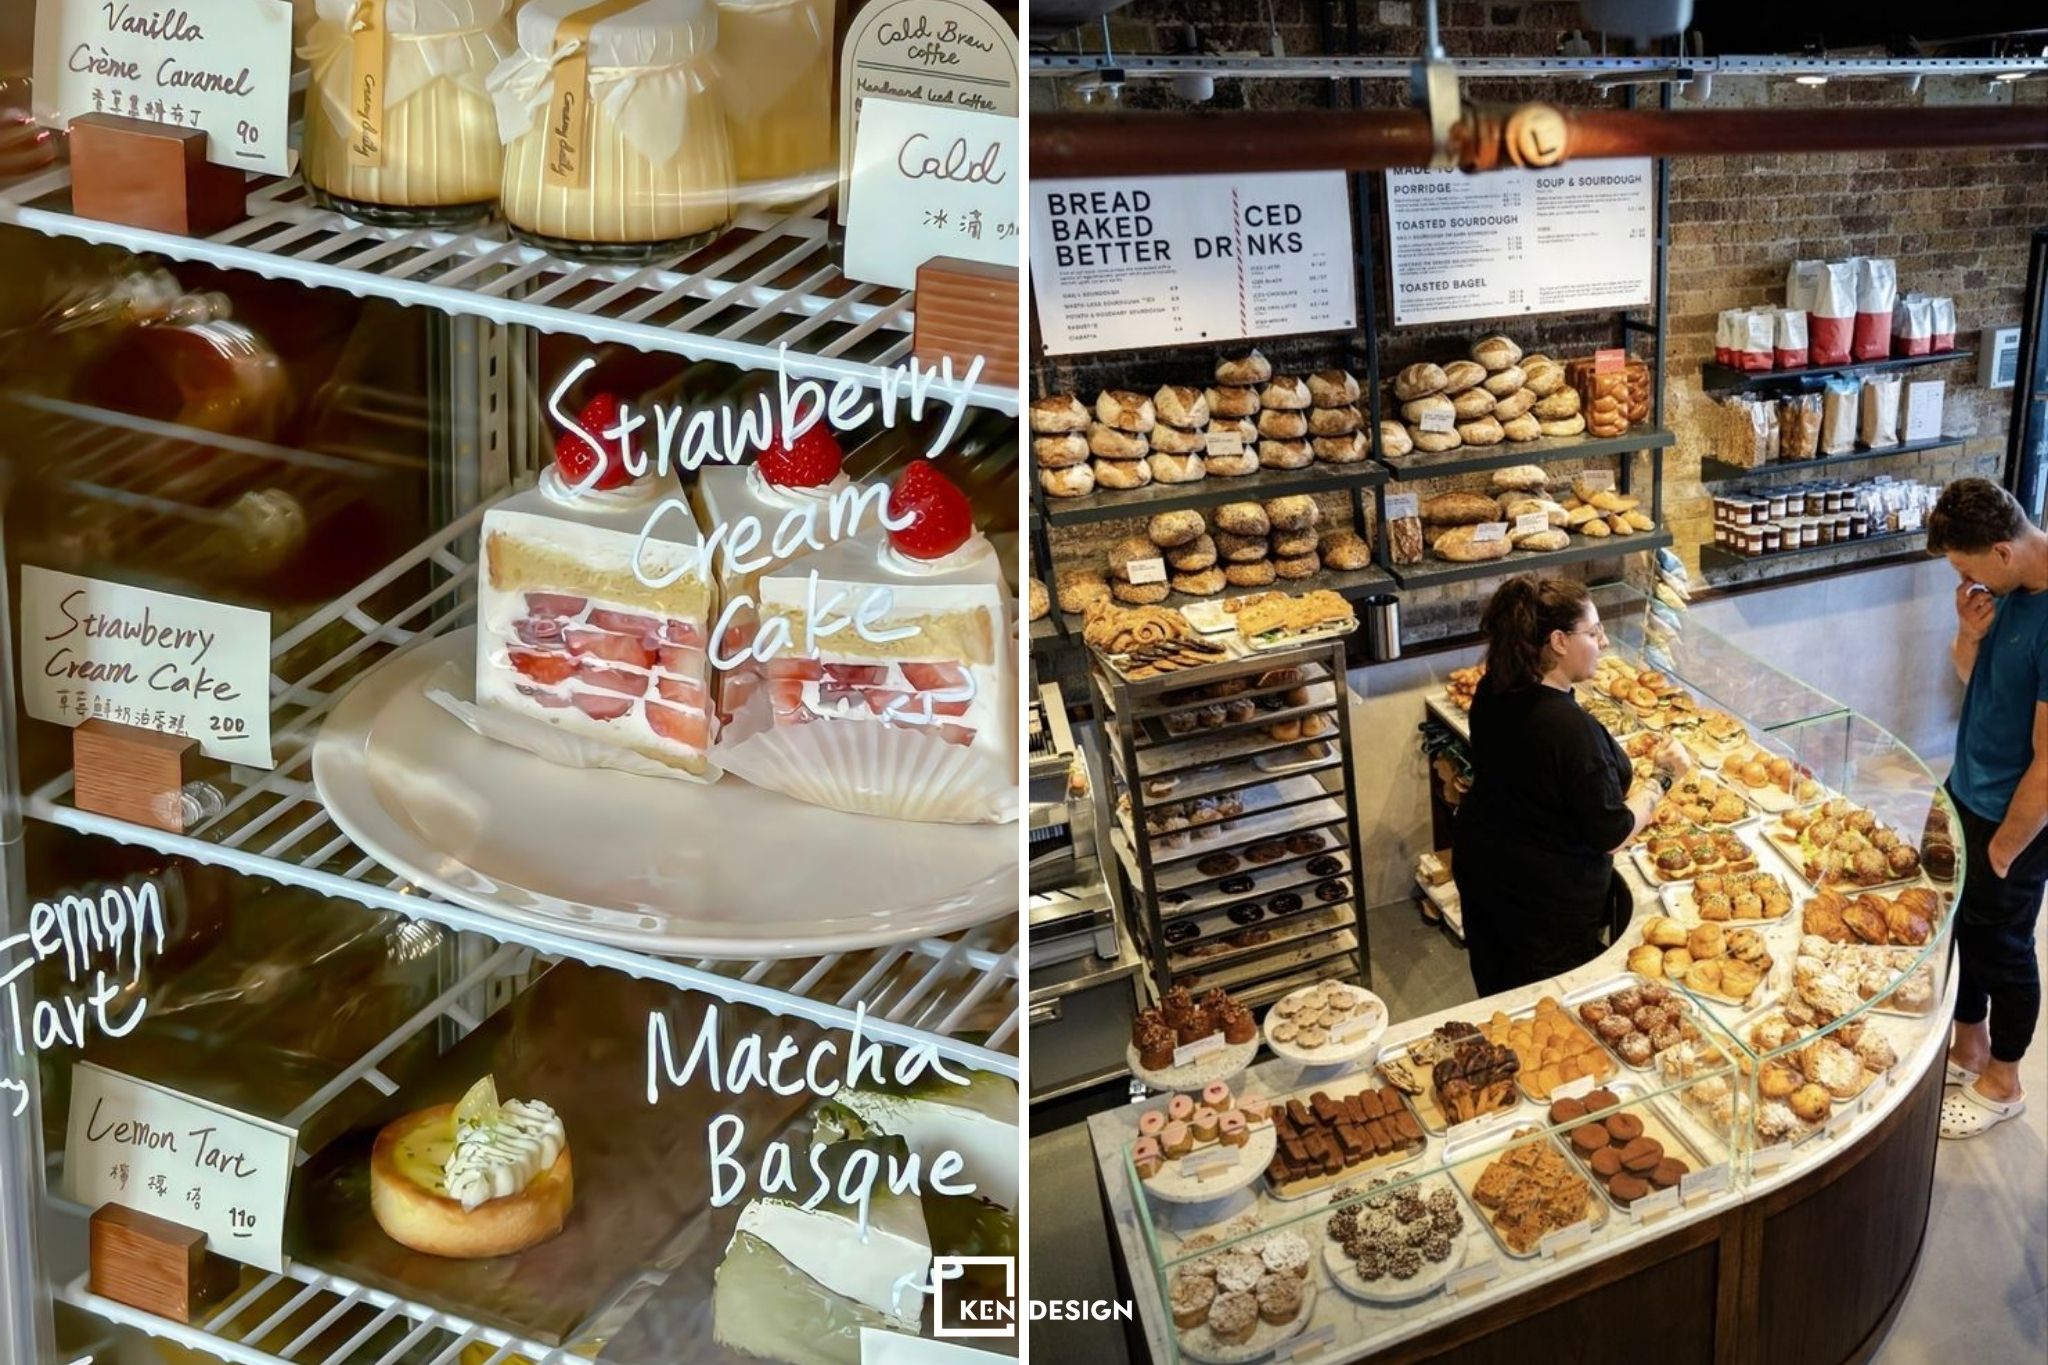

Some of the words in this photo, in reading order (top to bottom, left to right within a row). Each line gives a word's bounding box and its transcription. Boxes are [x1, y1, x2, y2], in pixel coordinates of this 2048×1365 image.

[103, 2, 204, 42] Vanilla
[937, 20, 993, 52] Brew
[68, 43, 141, 80] Crème
[156, 57, 255, 96] Caramel
[957, 91, 997, 111] Coffee
[236, 119, 260, 145] 90
[1393, 182, 1452, 195] PORRIDGE
[1536, 178, 1565, 189] SOUP
[1568, 178, 1575, 187] &
[1578, 174, 1642, 187] SOURDOUGH
[1047, 190, 1151, 216] BREAD
[1051, 216, 1154, 242] BAKED
[1396, 219, 1447, 231] TOASTED
[1450, 214, 1519, 228] SOURDOUGH
[1056, 239, 1172, 267] BETTER
[1399, 280, 1450, 293] TOASTED
[1452, 278, 1488, 290] BAGEL
[548, 341, 986, 499] Strawberry
[631, 481, 916, 589] Cream
[45, 590, 216, 666] Strawberry
[708, 568, 922, 670] Cake
[44, 647, 139, 684] Cream
[147, 662, 241, 702] Cake
[209, 715, 246, 734] 200
[646, 1000, 972, 1105] Matcha
[86, 1097, 177, 1153] Lemon
[188, 1127, 258, 1179] Tart
[707, 1113, 978, 1247] Basque
[227, 1206, 257, 1229] 110
